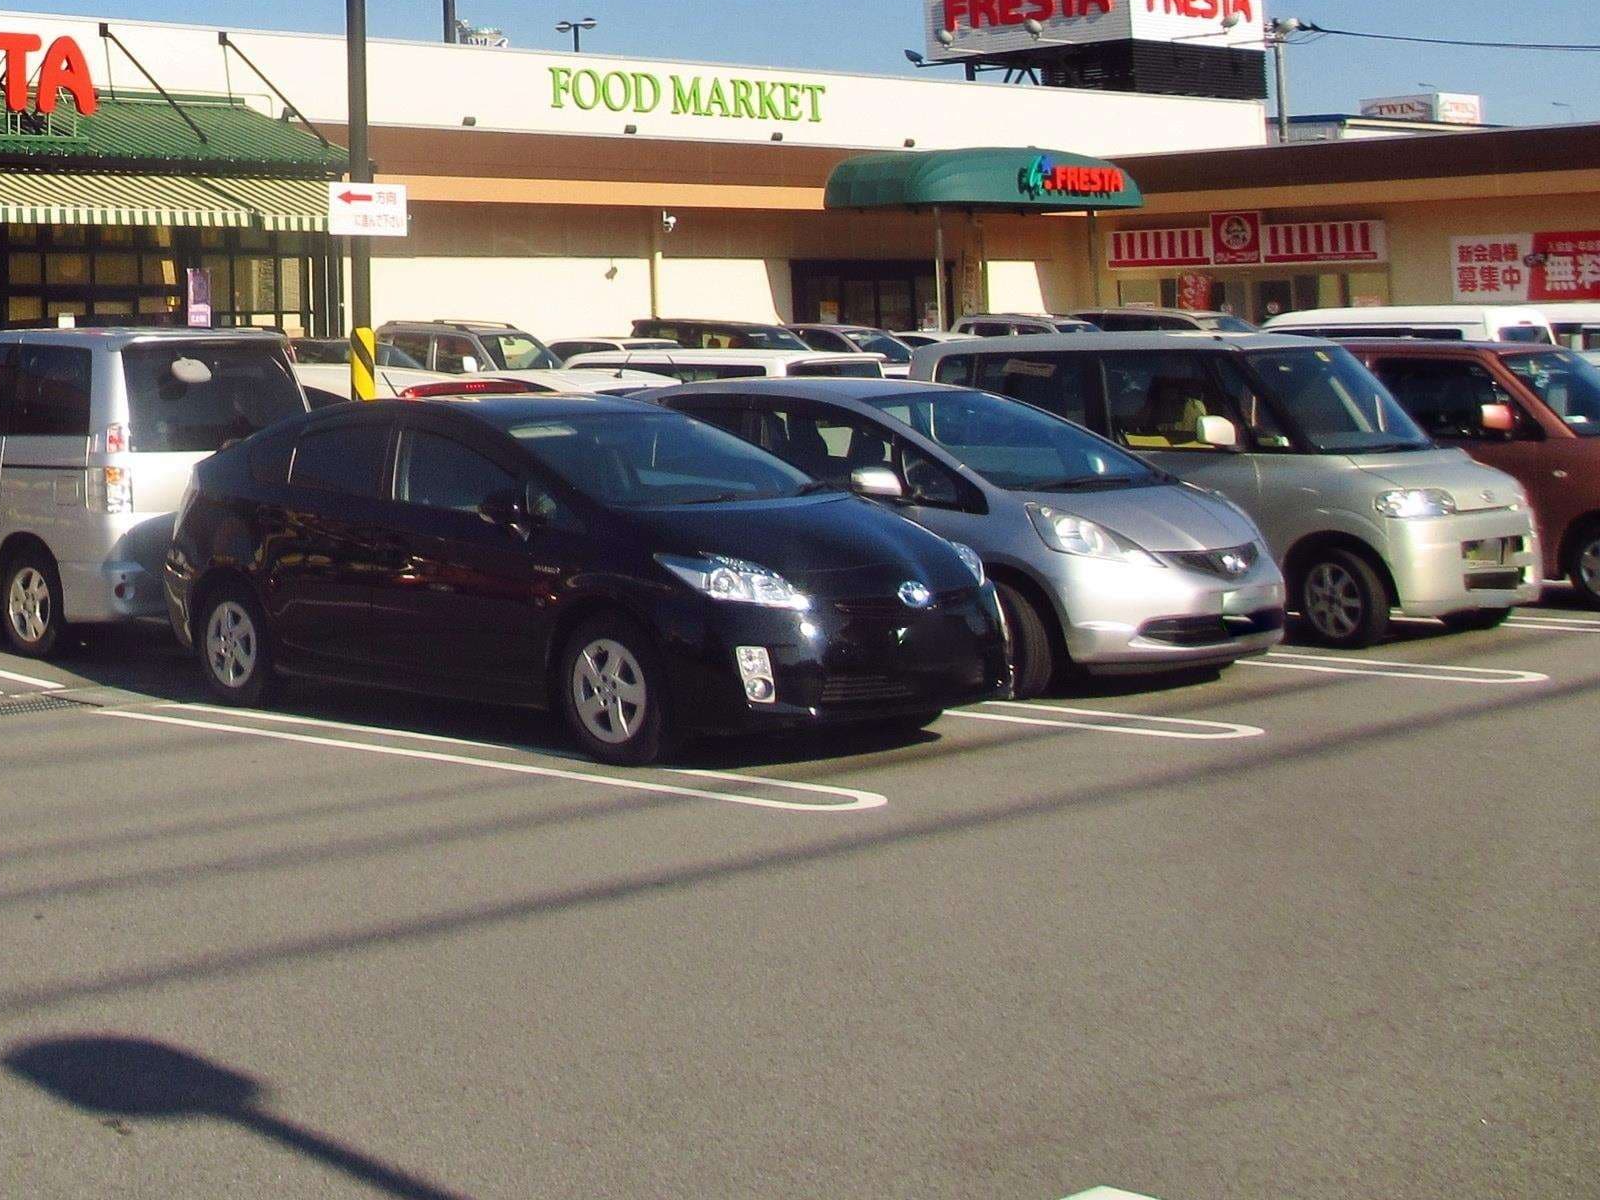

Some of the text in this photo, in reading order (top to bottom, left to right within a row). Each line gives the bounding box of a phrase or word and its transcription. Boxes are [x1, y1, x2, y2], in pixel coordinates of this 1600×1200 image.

[548, 66, 826, 123] FOOD MARKET
[1056, 166, 1125, 193] FRESTA
[1457, 265, 1522, 293] 募集中
